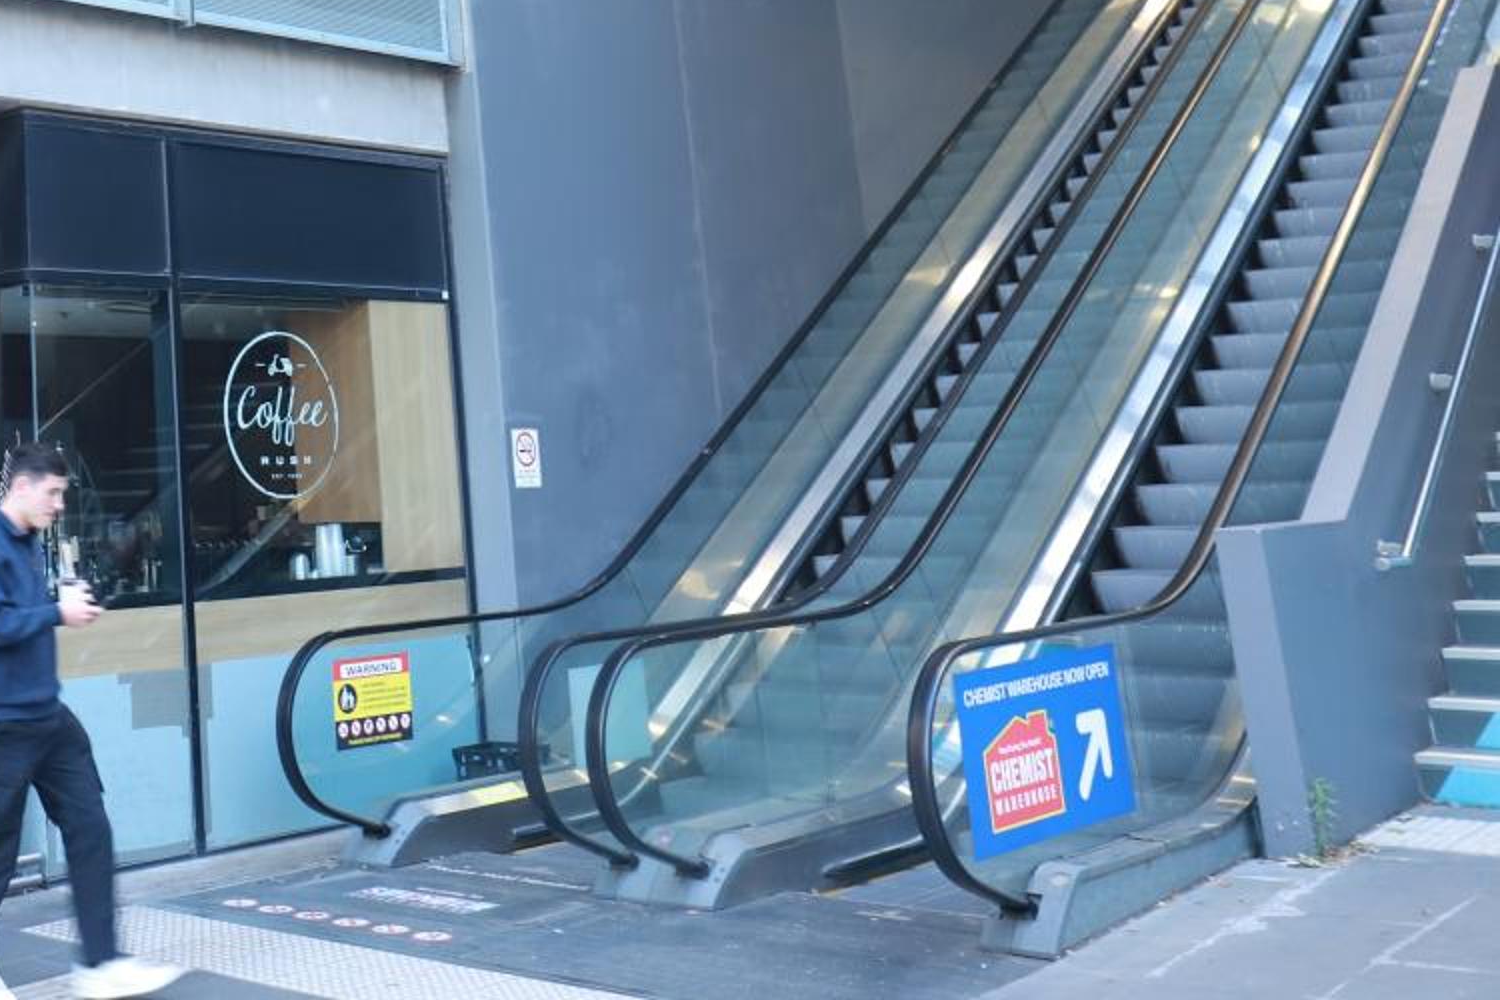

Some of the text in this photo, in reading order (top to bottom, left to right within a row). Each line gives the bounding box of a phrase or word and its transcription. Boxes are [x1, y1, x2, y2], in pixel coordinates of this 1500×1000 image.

[237, 384, 329, 447] Coffee
[963, 685, 1007, 708] CHEMIST
[991, 748, 1054, 795] CHEMIST
